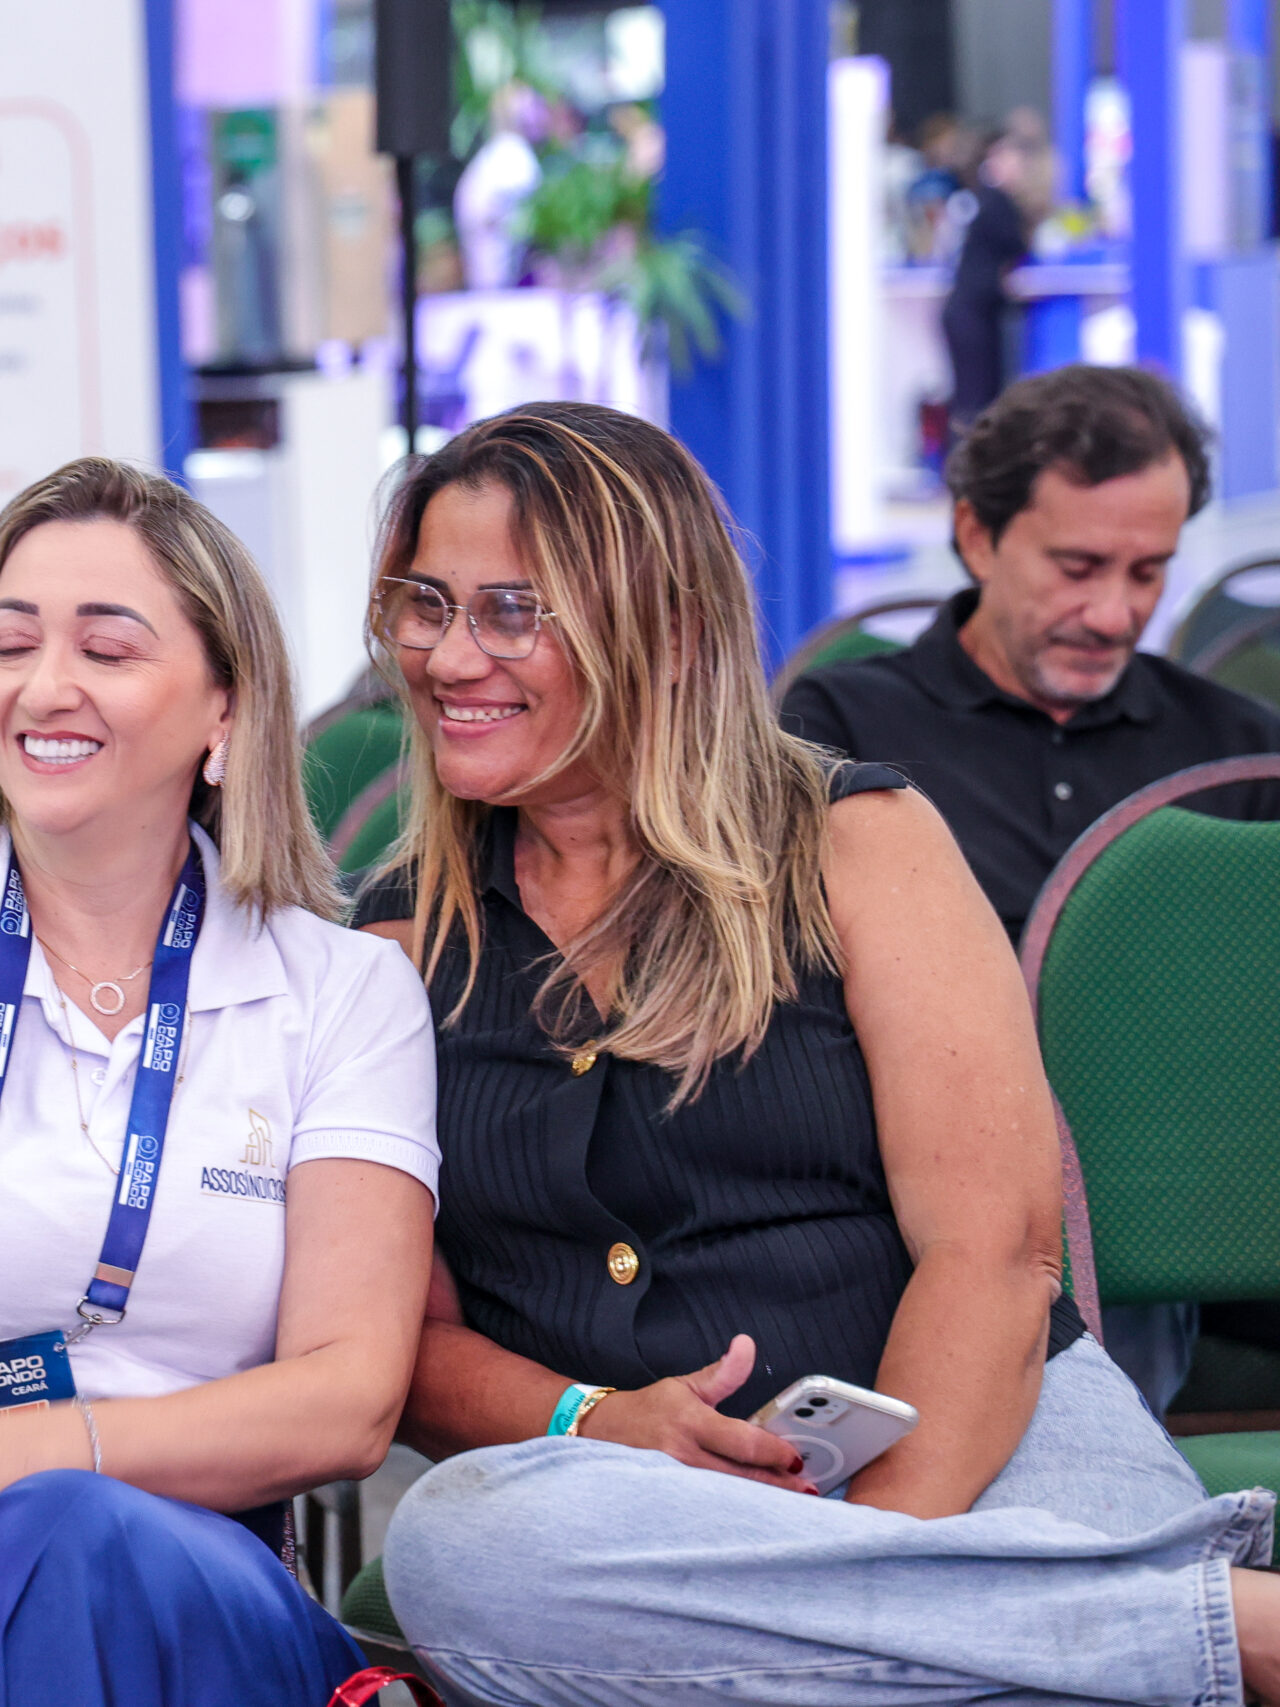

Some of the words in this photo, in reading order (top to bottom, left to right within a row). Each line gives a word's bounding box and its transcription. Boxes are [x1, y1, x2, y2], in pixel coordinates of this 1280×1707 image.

[4, 869, 20, 911] PAPO
[179, 913, 197, 949] PAPO
[151, 1025, 168, 1071] CONDO
[160, 1026, 177, 1073] PAPO
[127, 1159, 145, 1208] CONDO
[136, 1160, 155, 1210] PAPO
[11, 1380, 48, 1396] CEARÁ
